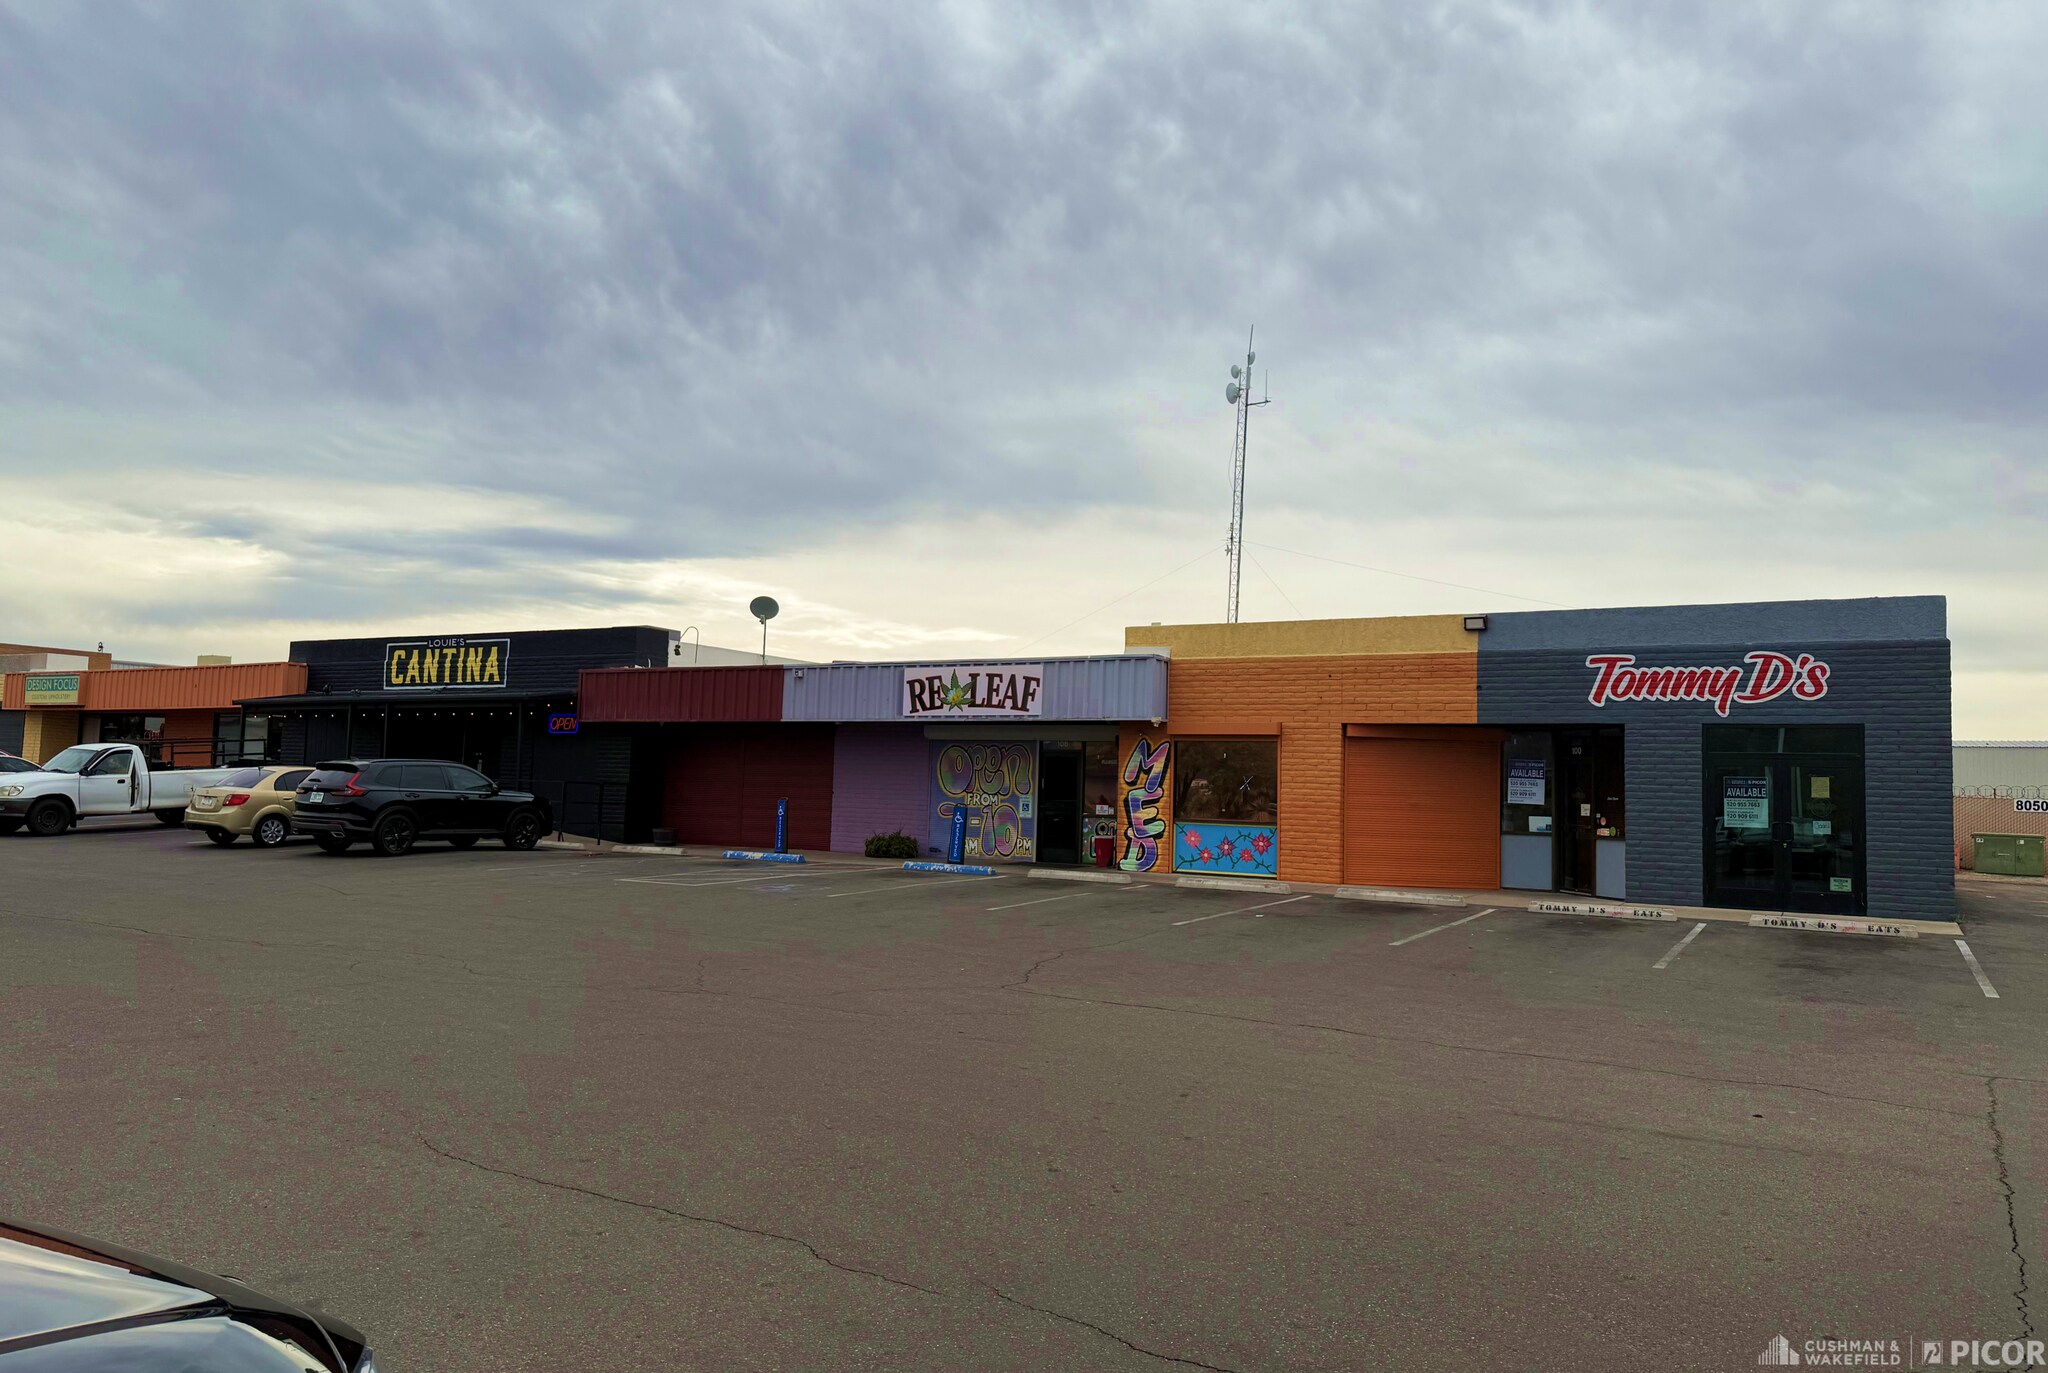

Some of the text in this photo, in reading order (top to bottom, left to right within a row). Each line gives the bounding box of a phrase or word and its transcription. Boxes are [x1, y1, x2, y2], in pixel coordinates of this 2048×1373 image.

[428, 638, 465, 648] LOUIE'S
[390, 646, 500, 685] CANTINA
[27, 678, 78, 691] DESIGN FOCUS
[1586, 651, 1830, 717] Tommy D's
[906, 672, 1041, 714] RE LEAF
[551, 717, 577, 730] OPEN
[1510, 768, 1544, 778] AVAILABLE
[967, 793, 998, 806] FROM
[1726, 787, 1767, 797] AVAILABLE
[953, 823, 961, 857] RESERVED
[1016, 839, 1032, 855] PM
[1538, 903, 1578, 913] TOMMY
[1588, 905, 1606, 914] D'S
[1633, 909, 1662, 918] EATS
[1762, 918, 1807, 928] TOMMY
[1817, 921, 1837, 930] D'S
[1867, 925, 1901, 934] EATS
